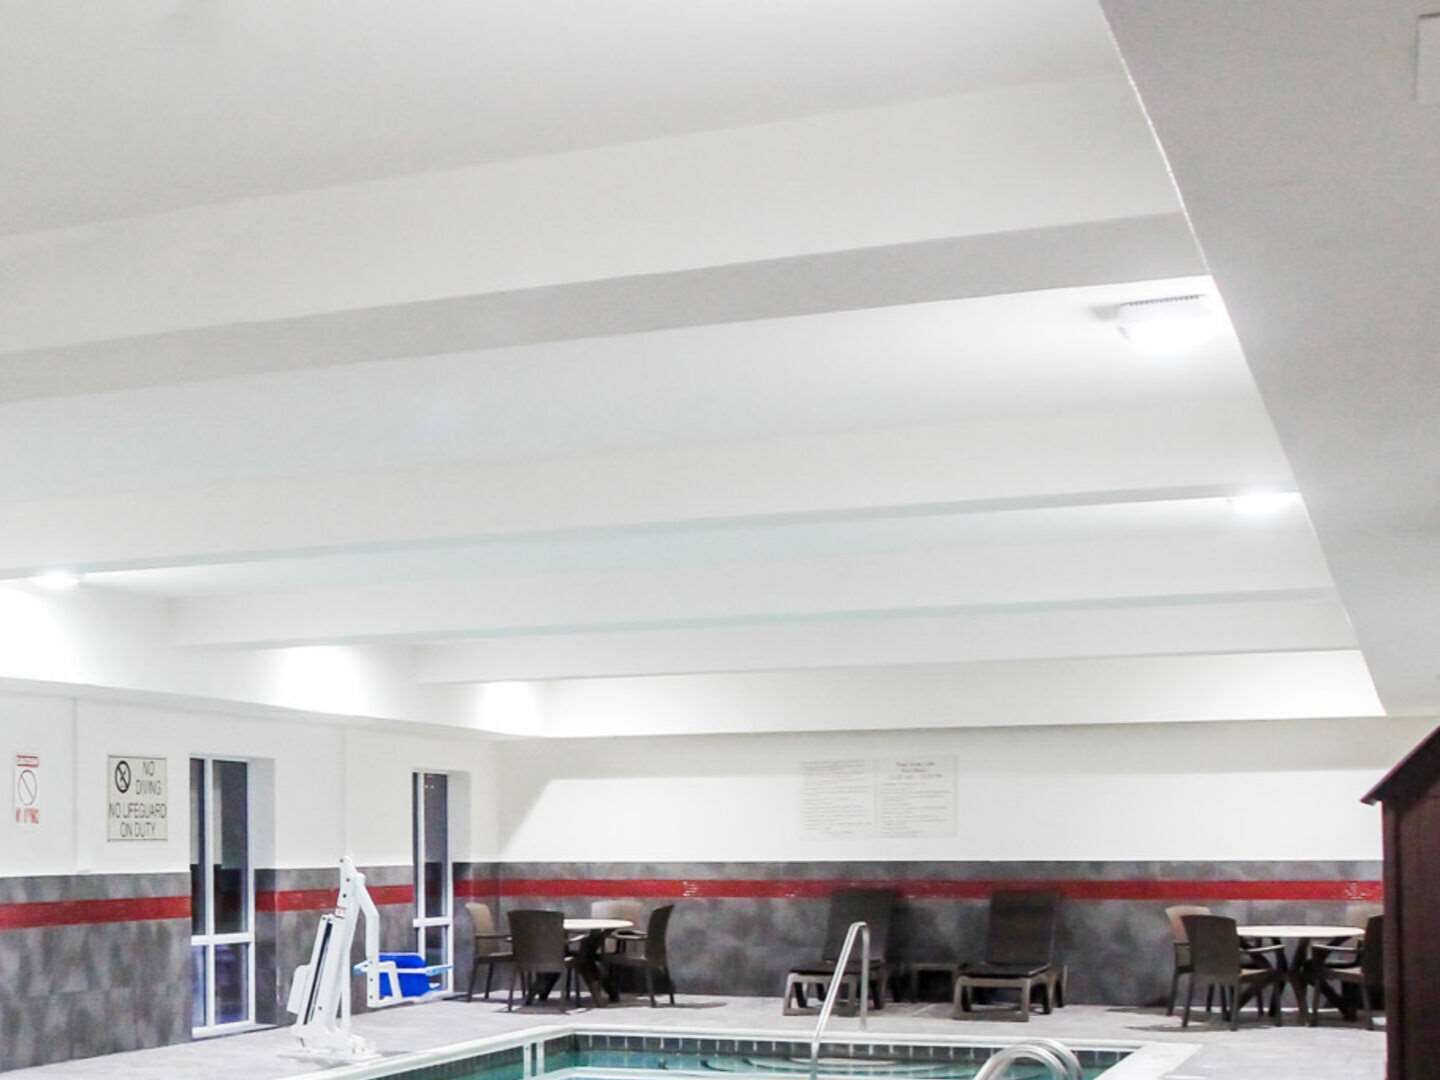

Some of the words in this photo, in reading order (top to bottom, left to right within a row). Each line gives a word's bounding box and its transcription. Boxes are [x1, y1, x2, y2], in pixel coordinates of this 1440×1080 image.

[143, 760, 156, 777] NO
[135, 779, 162, 796] DIVING
[108, 802, 121, 818] NO
[123, 802, 167, 818] LIFEGUARD
[120, 822, 133, 838] ON
[134, 822, 156, 838] DUTY
